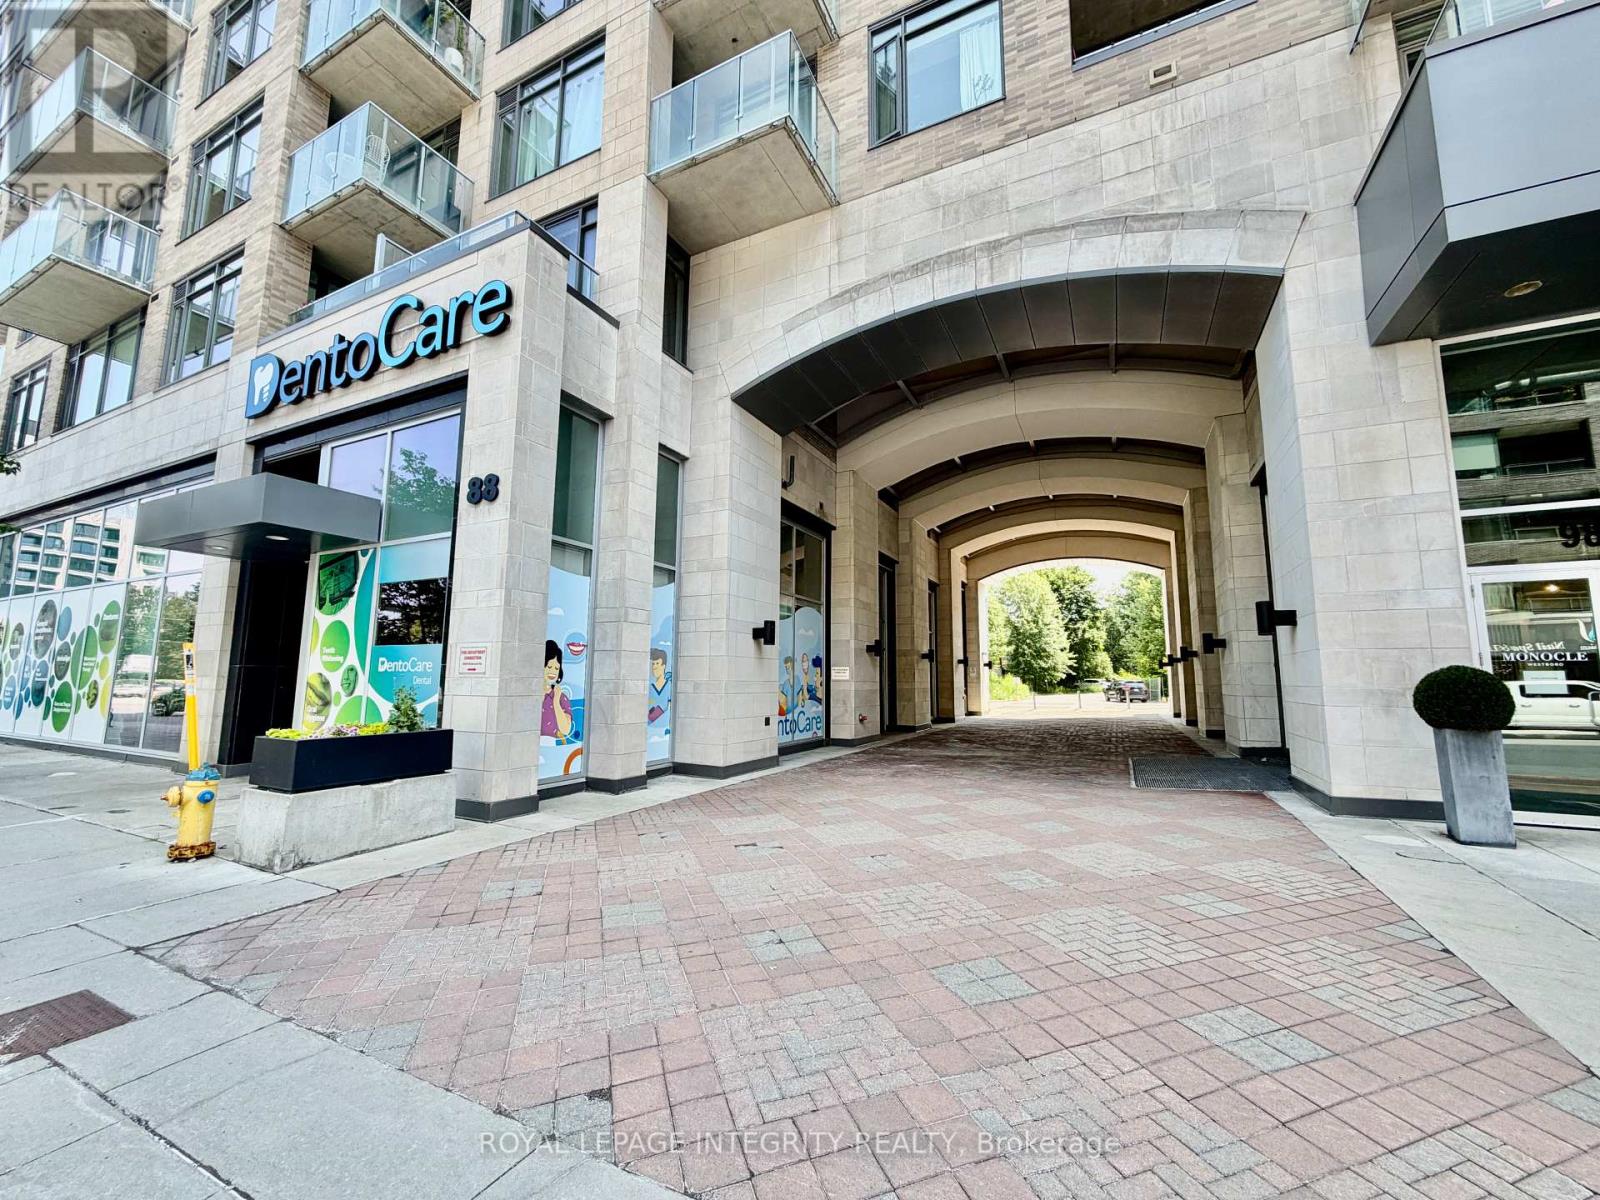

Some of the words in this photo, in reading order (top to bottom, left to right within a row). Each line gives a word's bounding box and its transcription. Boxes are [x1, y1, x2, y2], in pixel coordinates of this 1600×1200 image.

[245, 279, 513, 419] DentoCare
[466, 473, 500, 505] 88
[378, 657, 433, 673] DentoCare
[1501, 652, 1588, 662] MONOCLE
[413, 675, 432, 685] Dental
[777, 711, 822, 736] ntoCare
